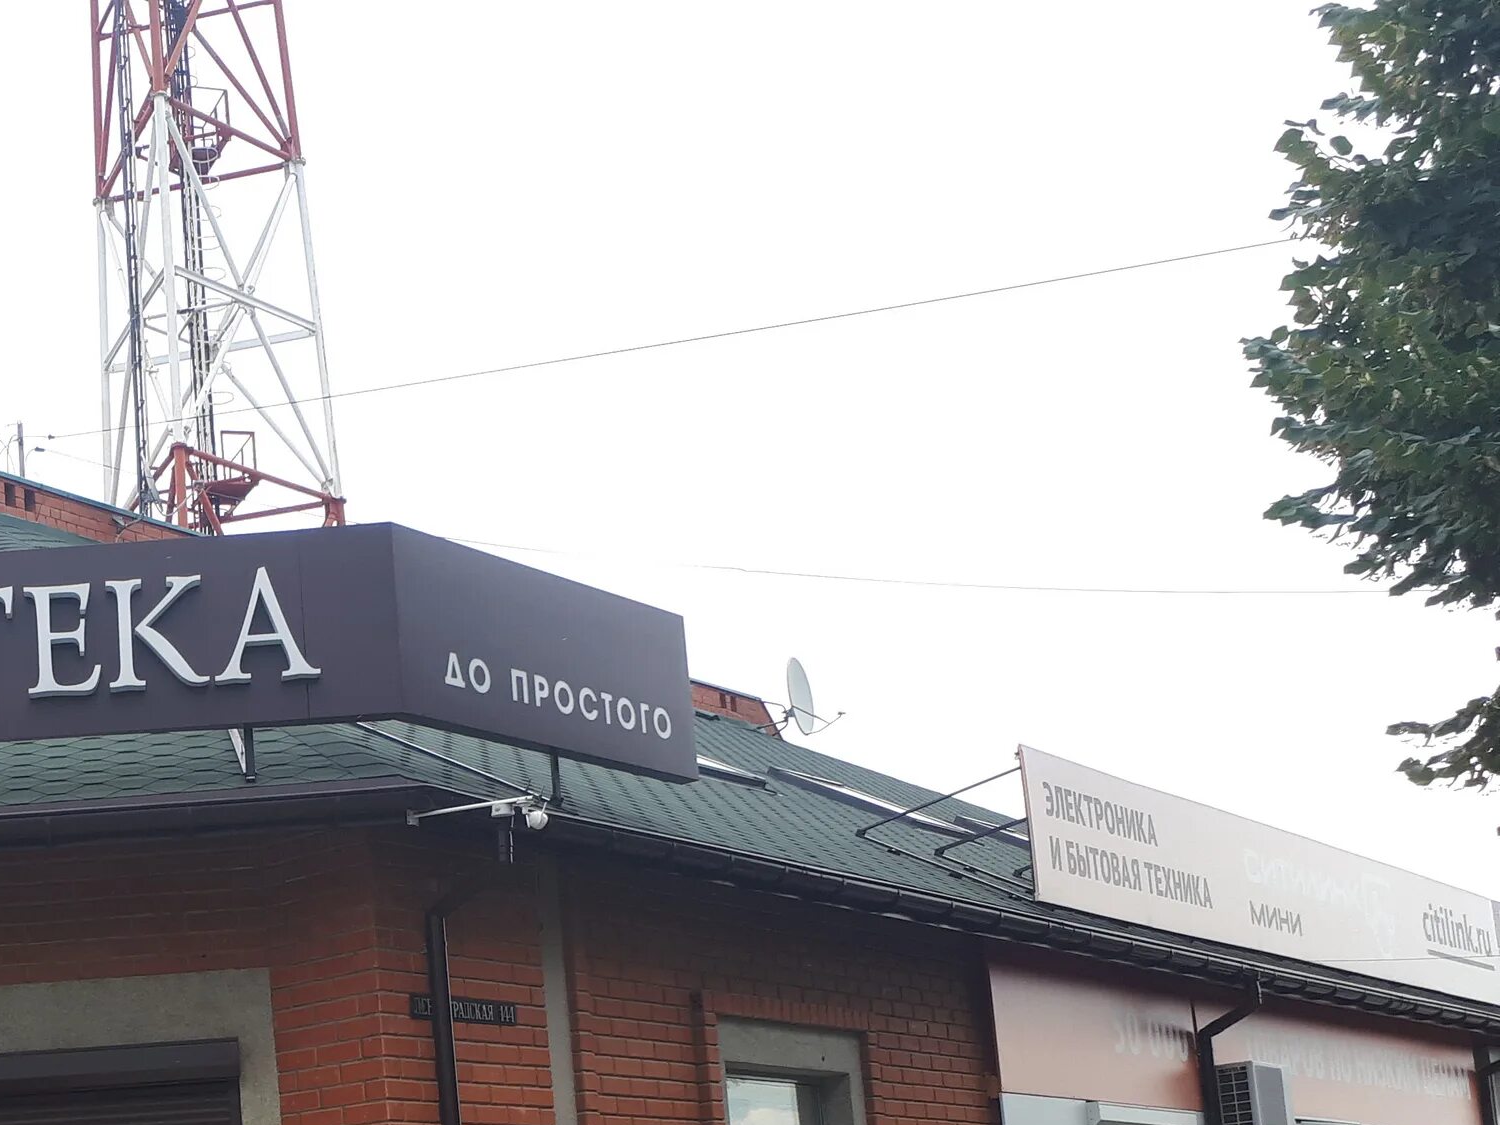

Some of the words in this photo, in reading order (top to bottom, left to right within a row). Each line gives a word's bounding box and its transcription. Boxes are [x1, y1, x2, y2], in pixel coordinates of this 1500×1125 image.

[444, 651, 491, 694] ДО
[510, 668, 672, 740] ПРОСТОГО
[1042, 781, 1158, 847] ЭЛЕКТРОНИКА
[1049, 835, 1063, 872] И
[1066, 839, 1143, 892] БЫТОВАЯ
[1143, 861, 1213, 910] ТЕХНИКА
[1249, 900, 1303, 937] МИНИ
[1423, 903, 1492, 957] citilink.ru
